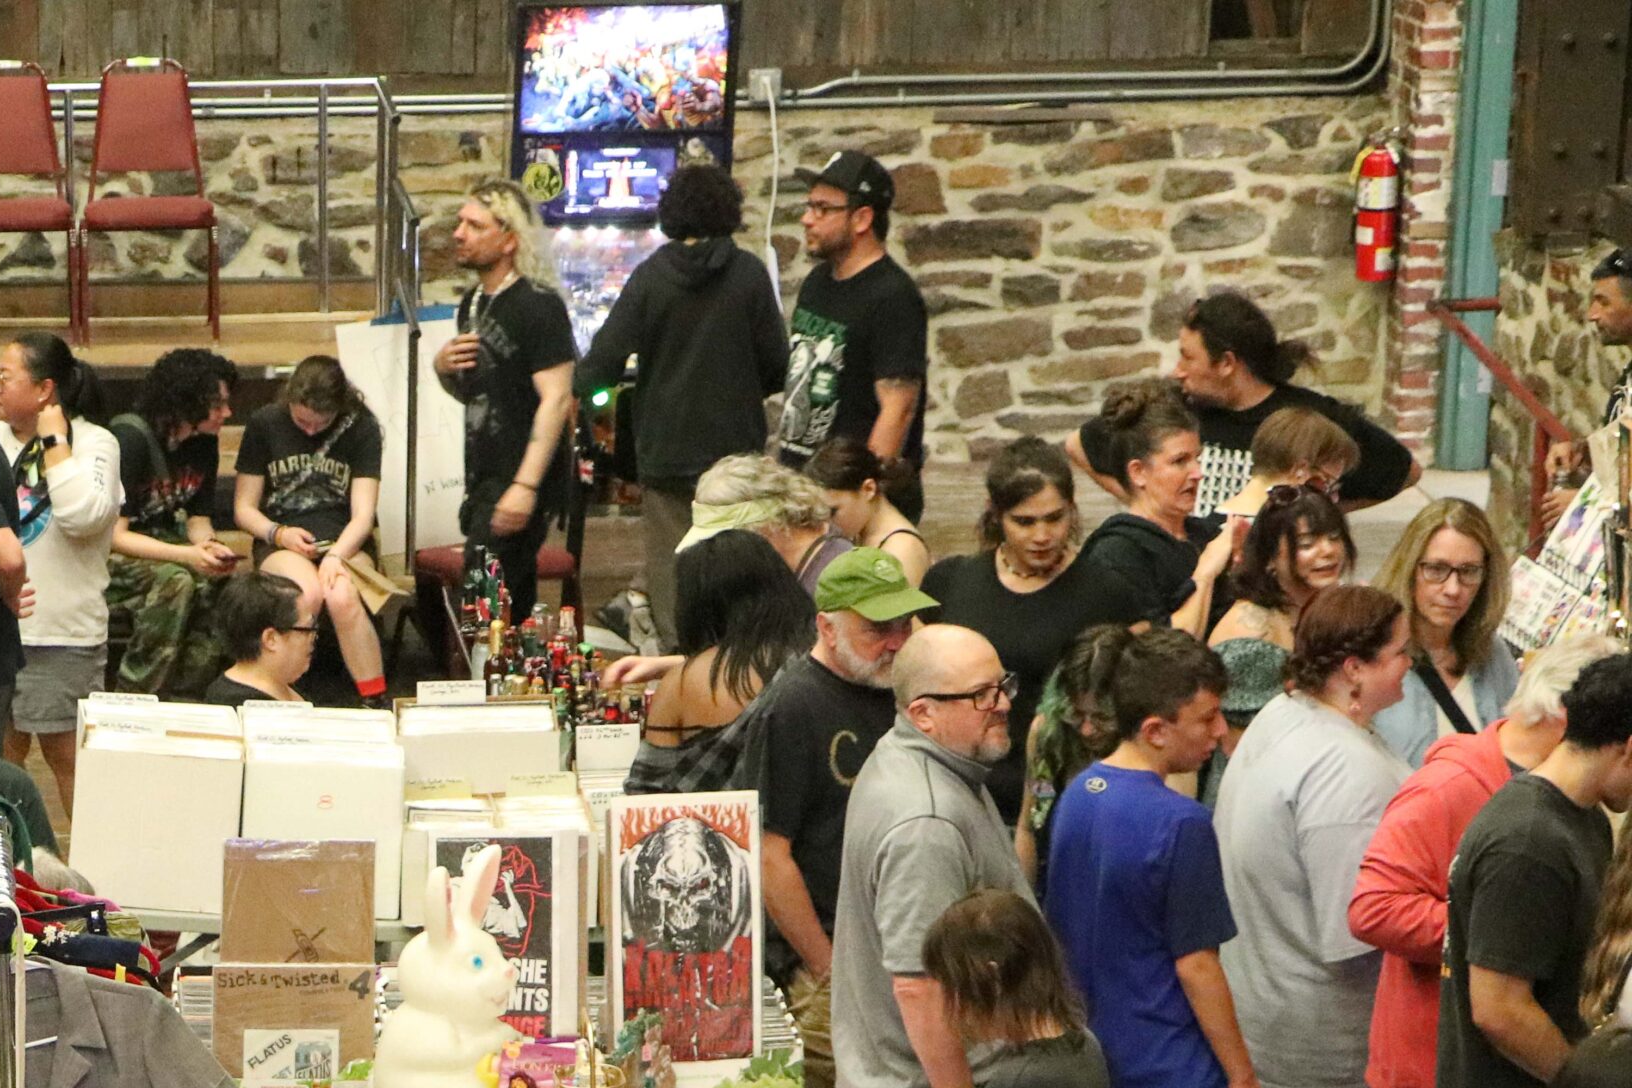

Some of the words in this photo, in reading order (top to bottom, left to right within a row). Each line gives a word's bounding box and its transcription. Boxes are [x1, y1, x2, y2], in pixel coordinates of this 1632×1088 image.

[218, 970, 256, 988] Sick
[270, 970, 341, 988] Twisted
[507, 986, 549, 1013] NTS
[247, 1033, 293, 1070] FLATUS
